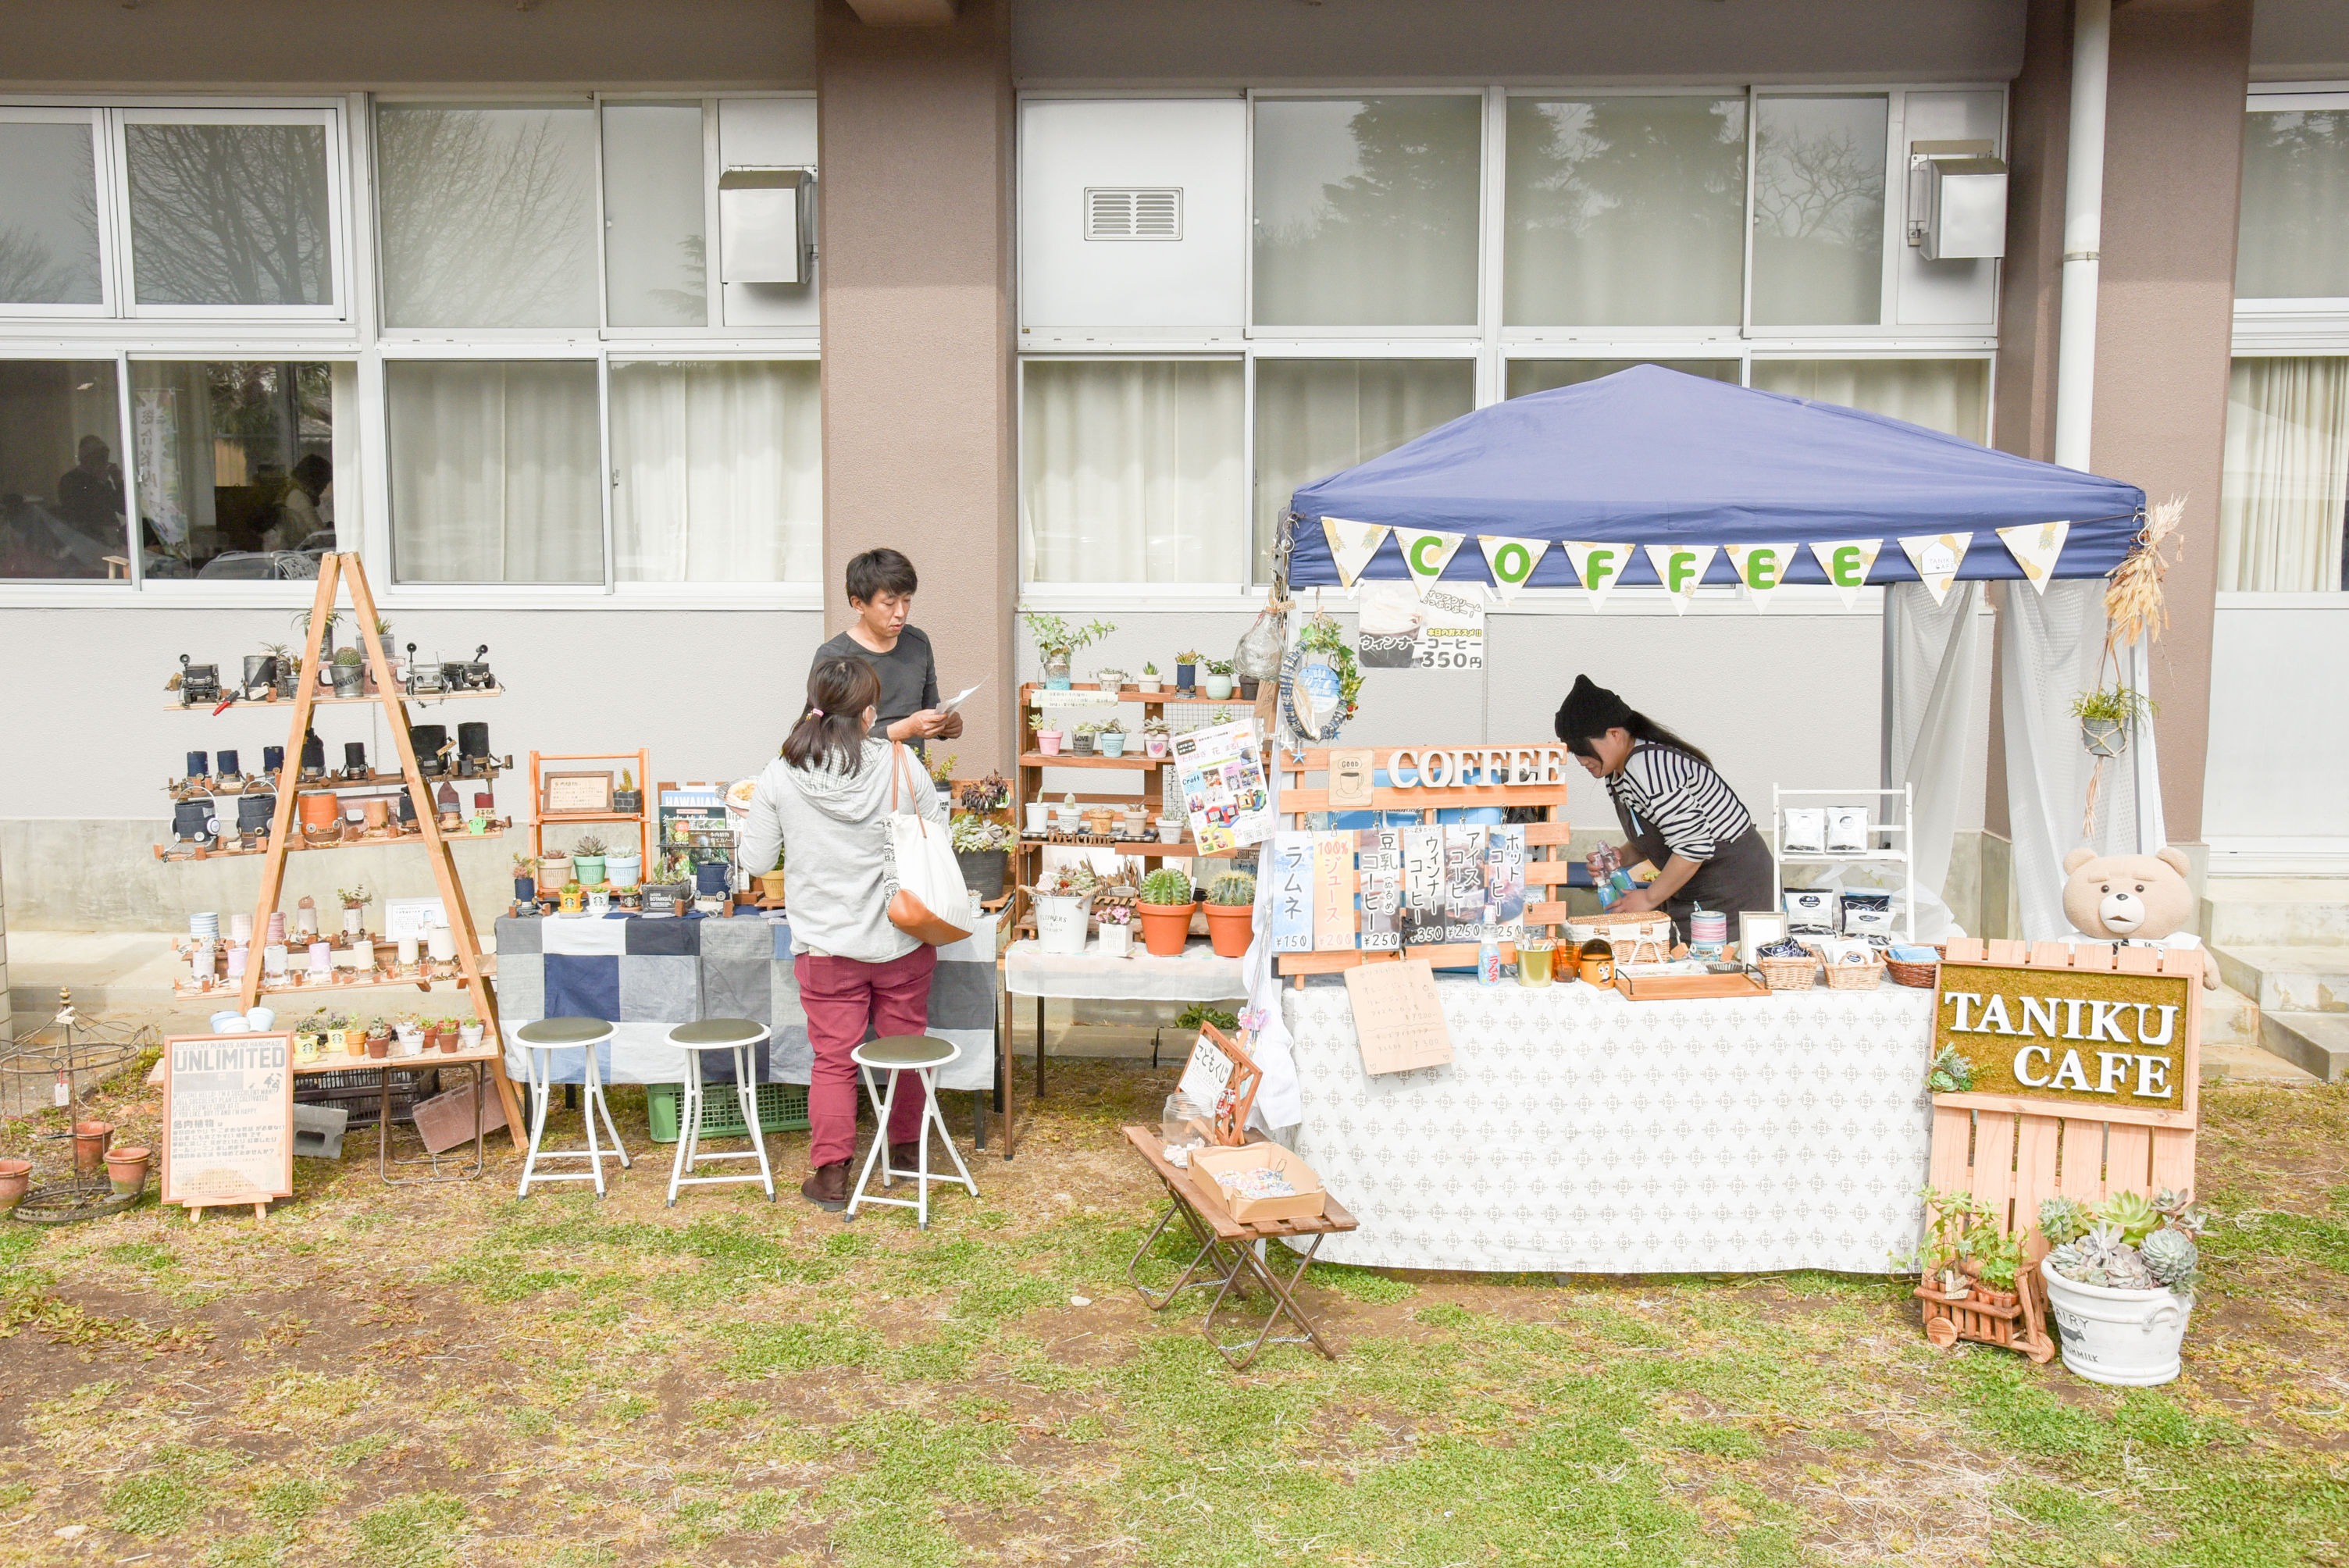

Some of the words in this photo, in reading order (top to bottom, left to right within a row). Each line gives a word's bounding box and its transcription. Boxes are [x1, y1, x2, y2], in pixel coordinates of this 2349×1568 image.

[1428, 590, 1482, 612] イップクリーム
[1360, 636, 1482, 650] ウィンナーコーヒー
[1421, 651, 1482, 668] 350円
[1212, 747, 1221, 756] 花
[1387, 747, 1566, 788] COFFEE
[1182, 775, 1200, 785] Craft
[665, 796, 720, 806] HAWAIIAN
[1047, 829, 1115, 845] Welcome
[1318, 841, 1349, 855] 100%
[1379, 833, 1398, 871] 豆乳
[1465, 832, 1480, 885] アイス
[1506, 834, 1521, 882] ホット
[546, 869, 564, 878] TANIKU
[1285, 846, 1302, 919] ラムネ
[1426, 836, 1440, 914] ウィンナー
[1451, 852, 1463, 917] コーヒー
[1492, 850, 1504, 915] コーヒー
[1324, 856, 1342, 922] ジュース
[1363, 856, 1378, 930] コーヒー
[1410, 860, 1423, 924] コーヒー
[1104, 930, 1122, 939] TANIKU
[1276, 935, 1307, 947] ¥150
[1319, 933, 1352, 946] ¥200
[1364, 934, 1398, 946] ¥250
[1448, 925, 1480, 938] ¥250
[1108, 939, 1117, 949] LIFE
[1488, 955, 1499, 982] ラムネ
[1944, 991, 2179, 1046] TANIKU
[173, 1046, 286, 1072] UNLIMITED
[1195, 1044, 1229, 1083] こどもくじ
[2013, 1045, 2172, 1098] CAFE
[173, 1119, 215, 1129] 多肉植物
[2055, 1308, 2090, 1328] AIRY
